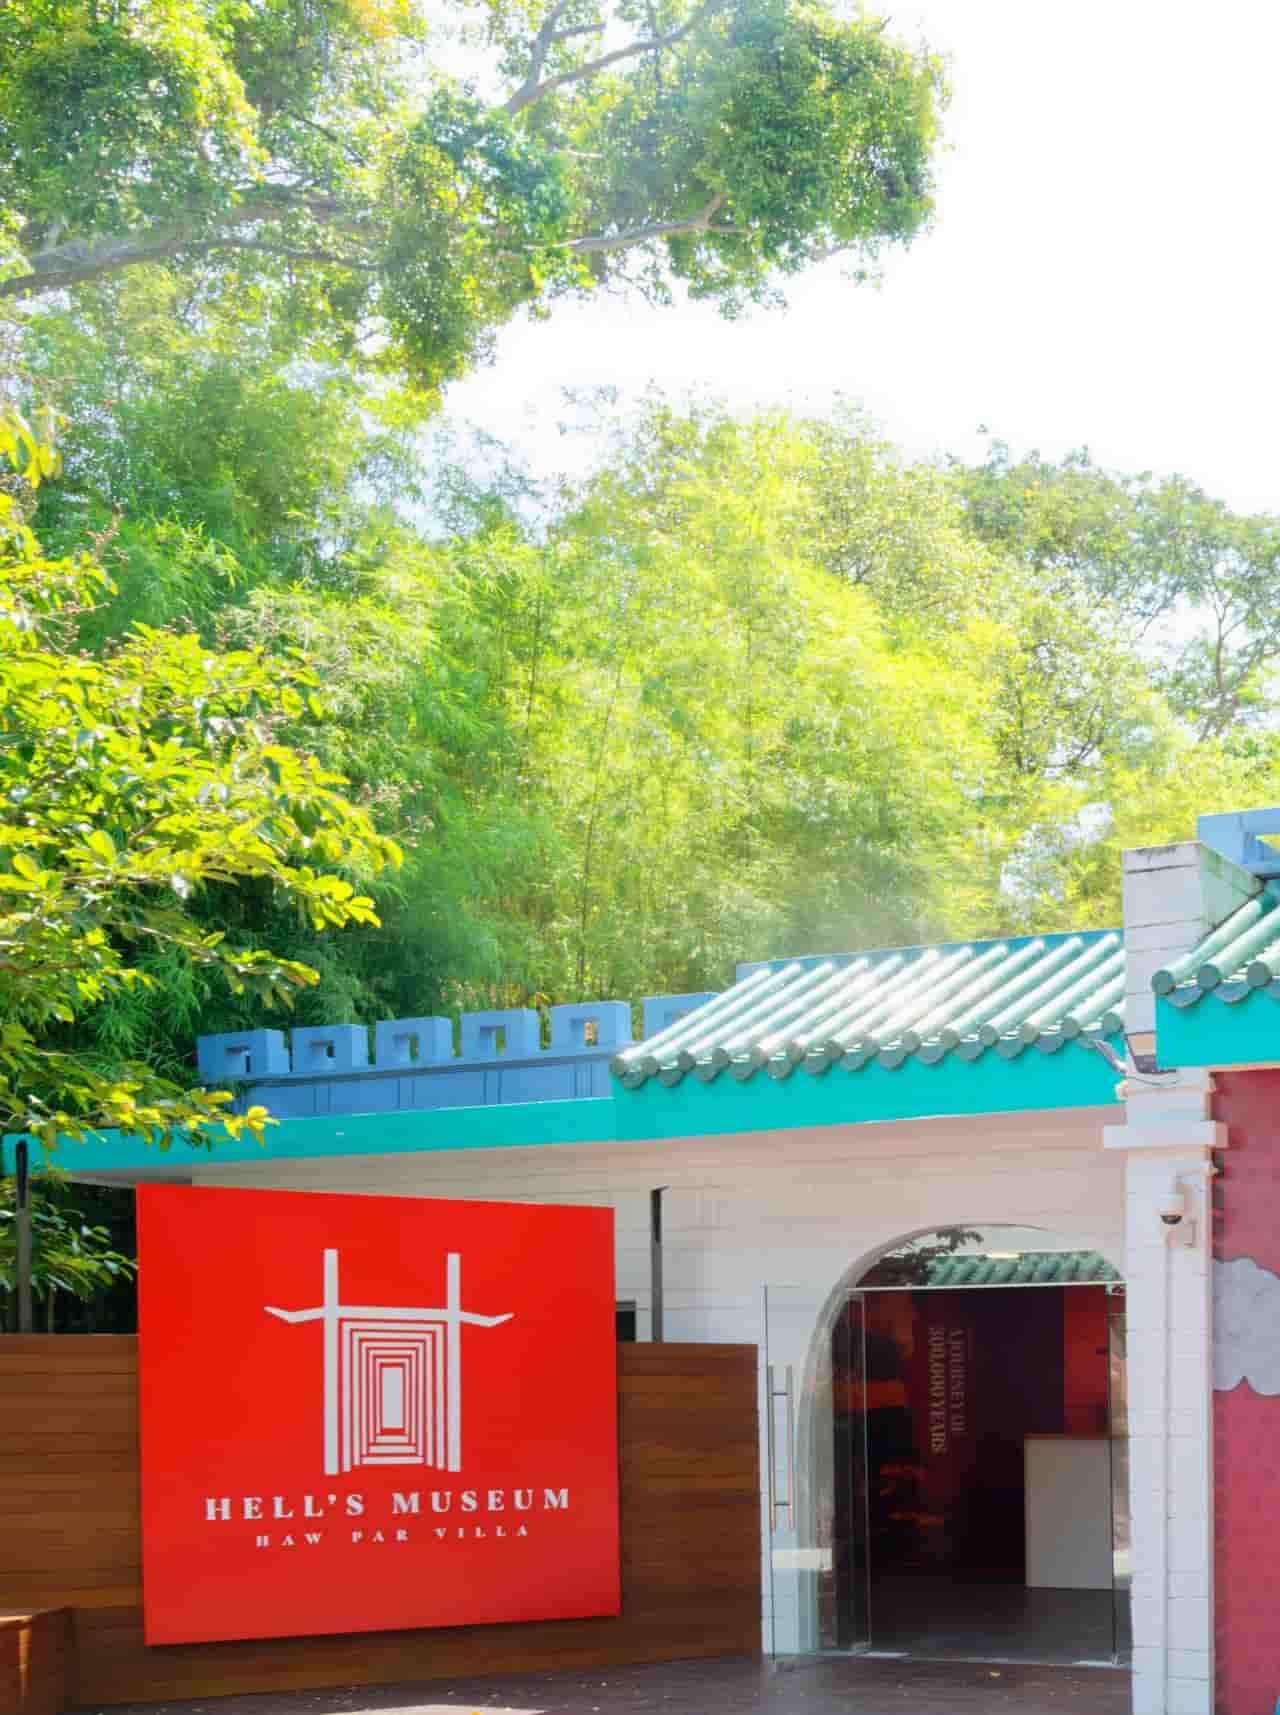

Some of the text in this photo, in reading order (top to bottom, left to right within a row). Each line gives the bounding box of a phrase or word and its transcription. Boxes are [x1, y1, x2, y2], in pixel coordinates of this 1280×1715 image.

[205, 1488, 570, 1521] HELL'S MUSEUM
[256, 1525, 529, 1547] HAW PAR VILLA
